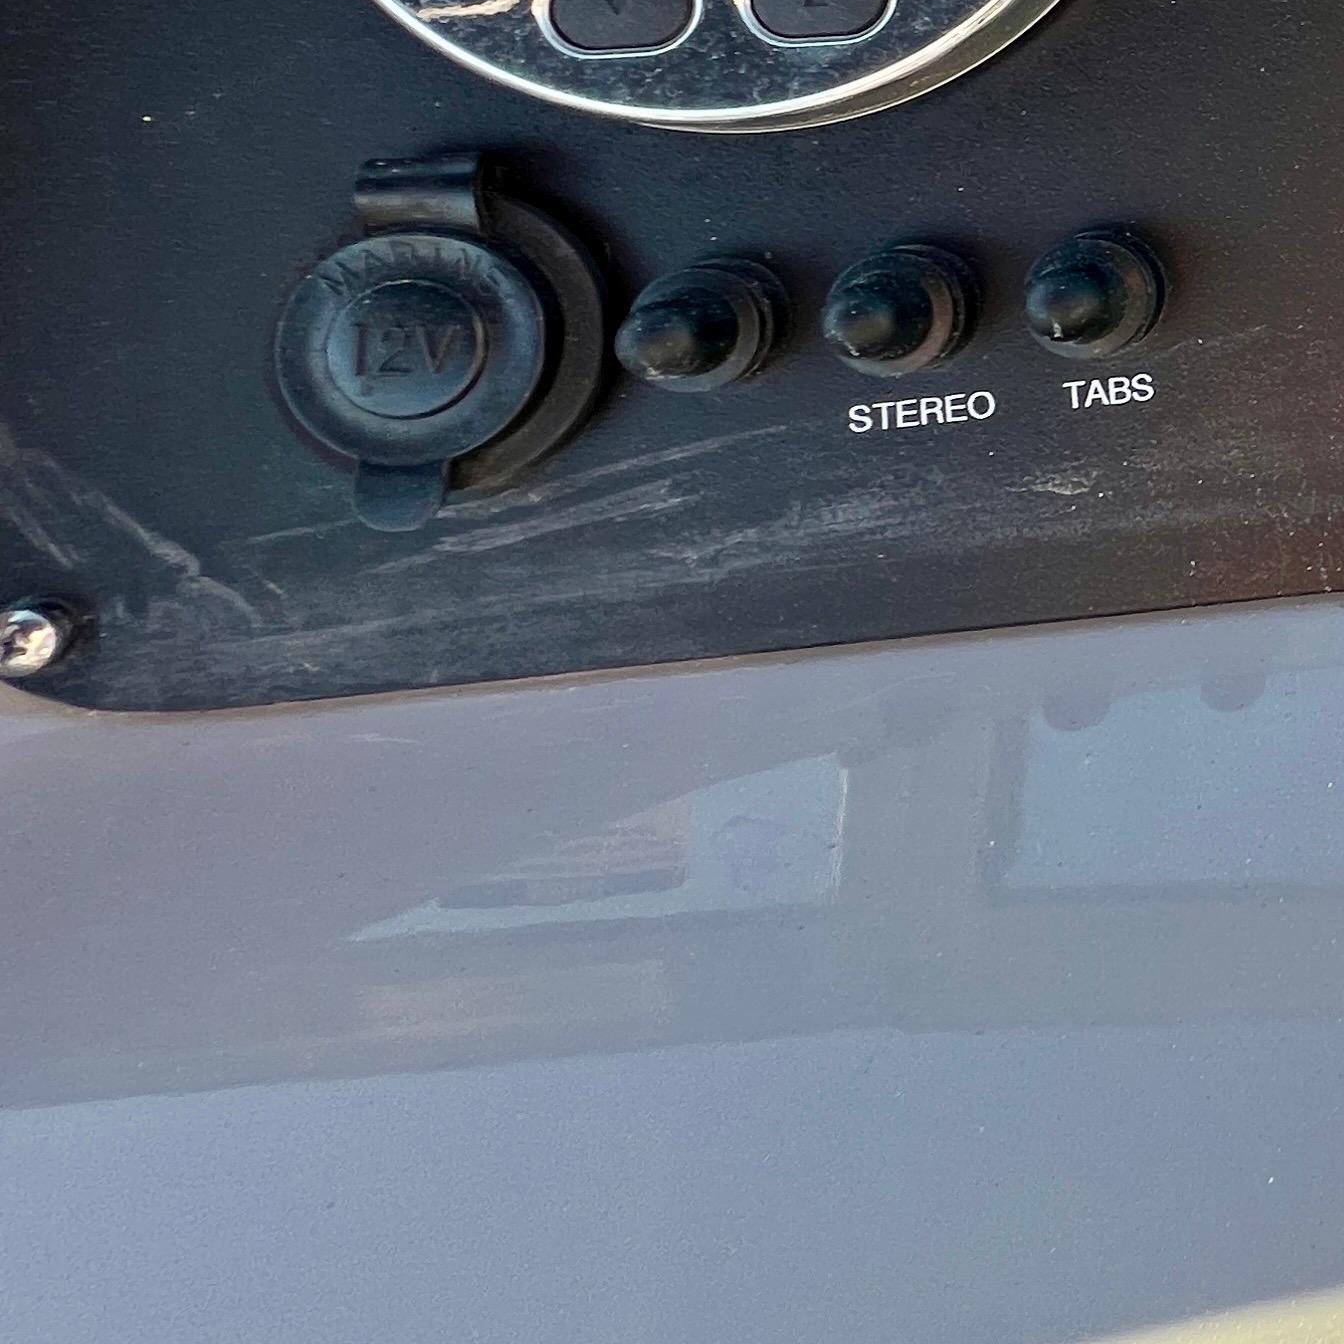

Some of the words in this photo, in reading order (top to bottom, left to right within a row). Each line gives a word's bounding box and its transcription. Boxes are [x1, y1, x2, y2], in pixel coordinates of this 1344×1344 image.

[353, 321, 461, 378] 12V
[848, 391, 996, 433] STEREO
[1061, 373, 1155, 409] TABS
